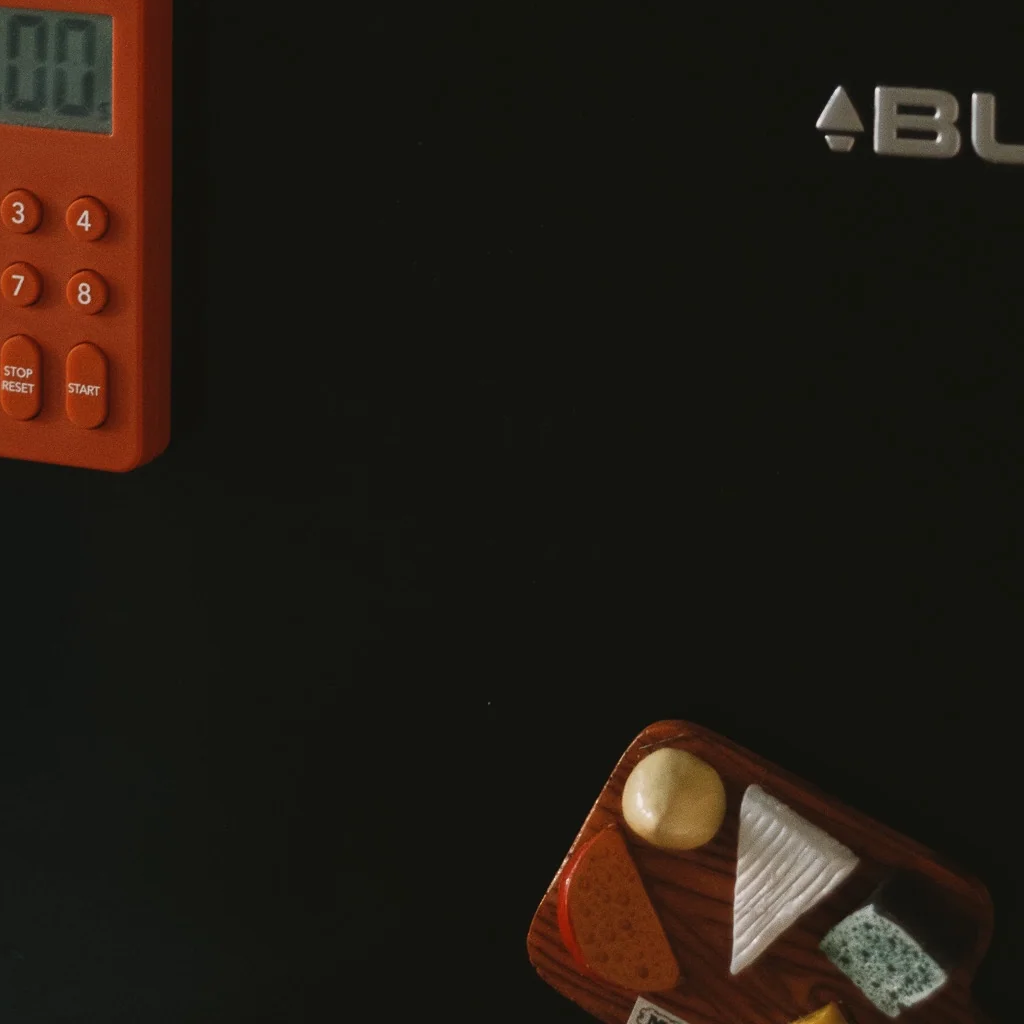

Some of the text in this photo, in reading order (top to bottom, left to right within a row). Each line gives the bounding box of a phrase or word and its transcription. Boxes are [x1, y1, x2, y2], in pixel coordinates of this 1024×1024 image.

[11, 201, 25, 224] 3
[76, 210, 92, 232] 4
[11, 274, 25, 296] 7
[77, 282, 92, 305] 8
[3, 365, 33, 379] STOP
[1, 380, 35, 394] RESET
[67, 382, 101, 397] START
